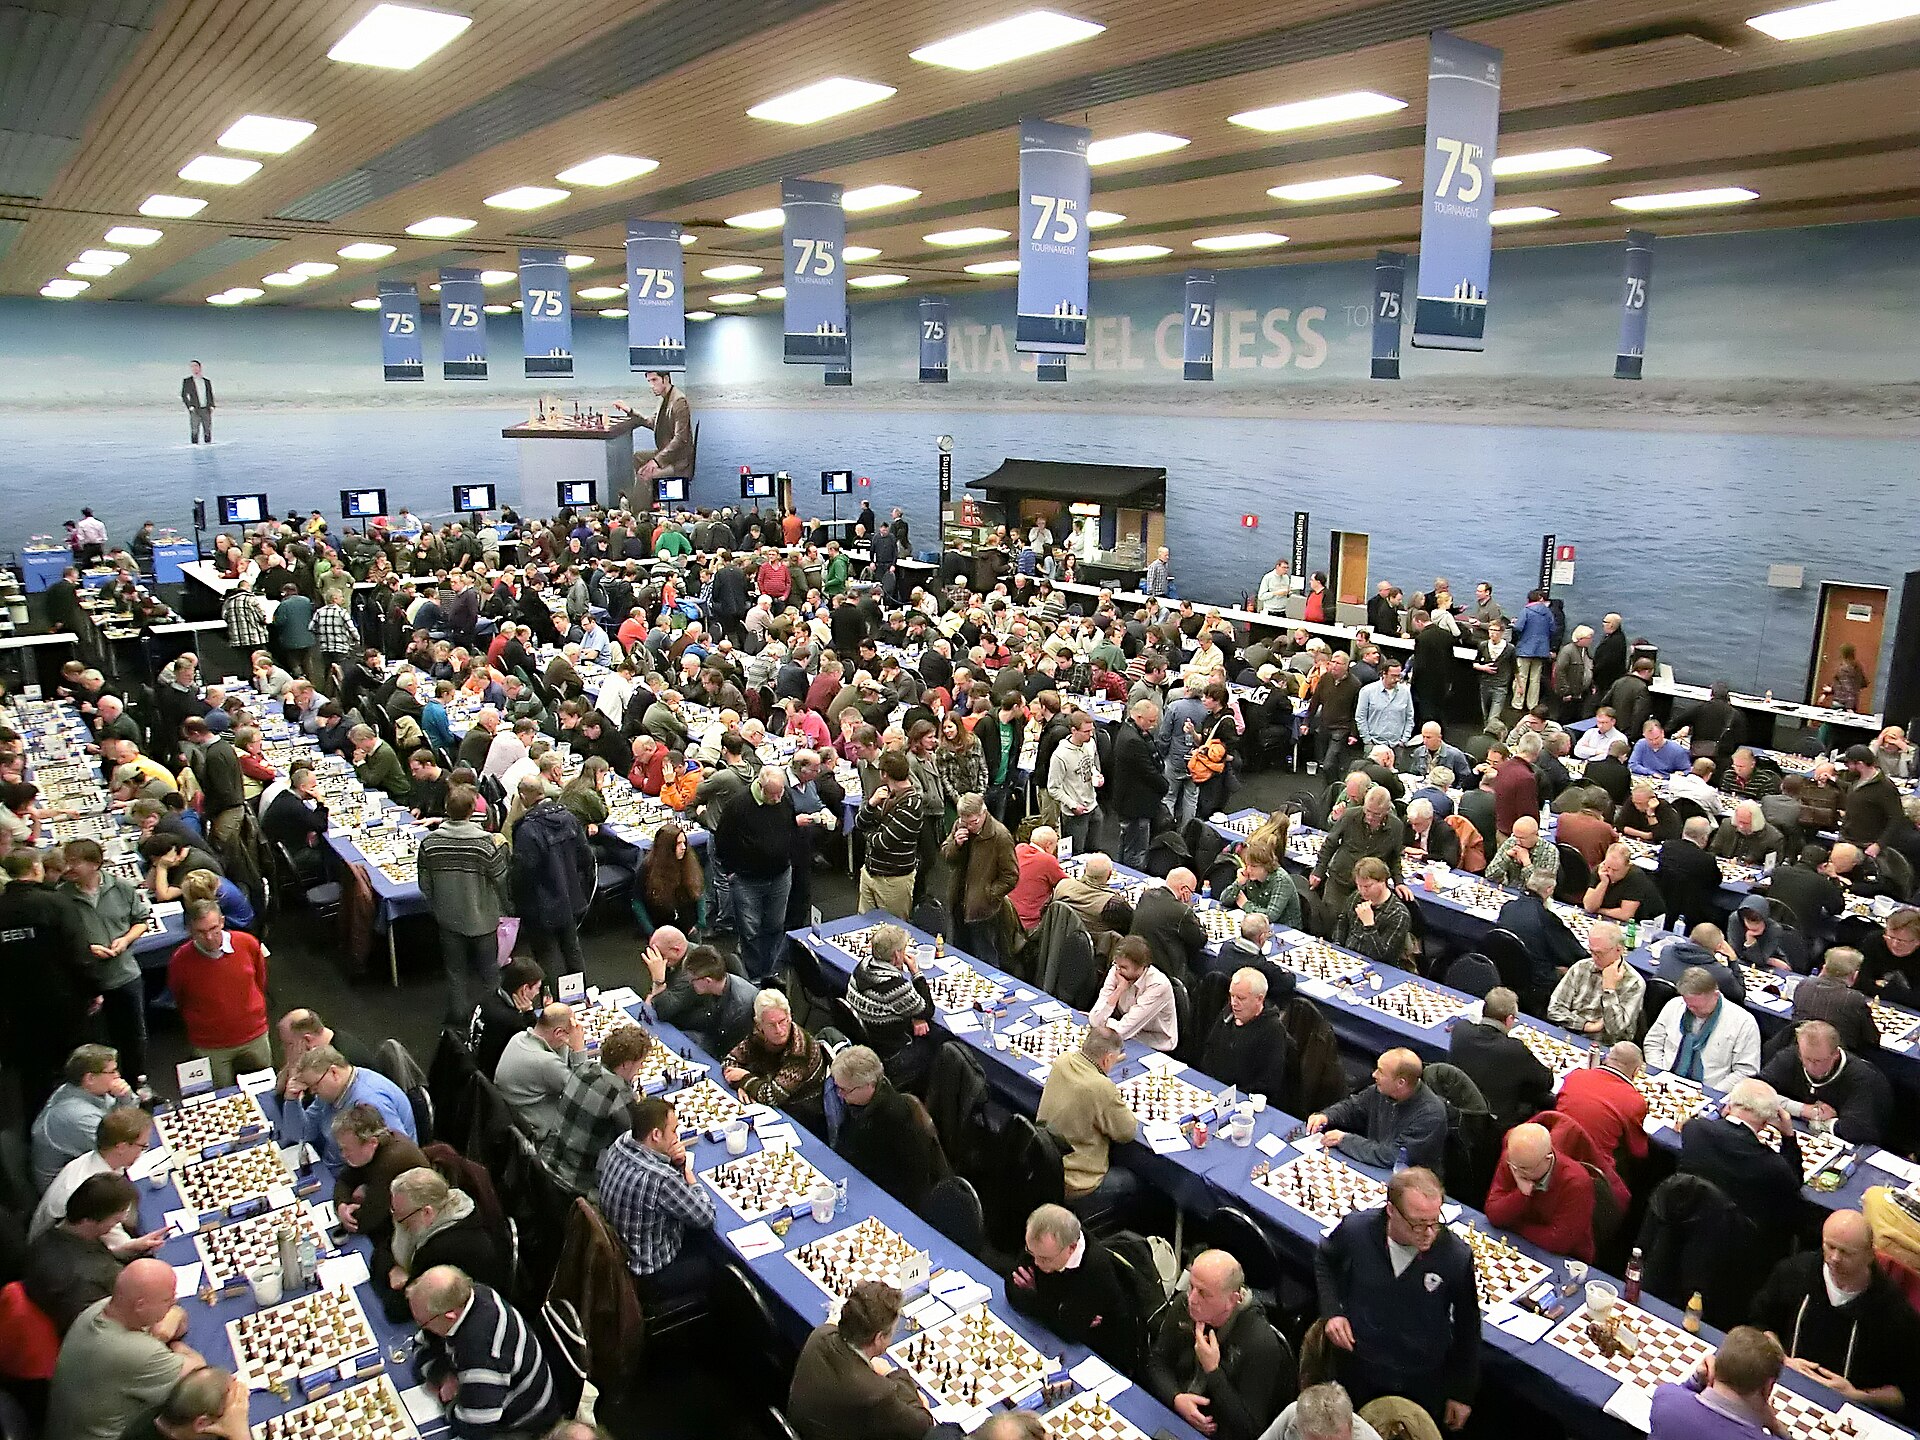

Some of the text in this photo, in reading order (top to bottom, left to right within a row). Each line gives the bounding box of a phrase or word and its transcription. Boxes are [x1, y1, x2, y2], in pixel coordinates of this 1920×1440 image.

[1433, 201, 1479, 219] TOURNAMENT
[1031, 243, 1076, 256] TOURNAMENT
[794, 276, 834, 286] TOURNAMENT
[948, 321, 1012, 373] ATA
[942, 456, 950, 491] catering
[189, 1069, 204, 1078] 4G
